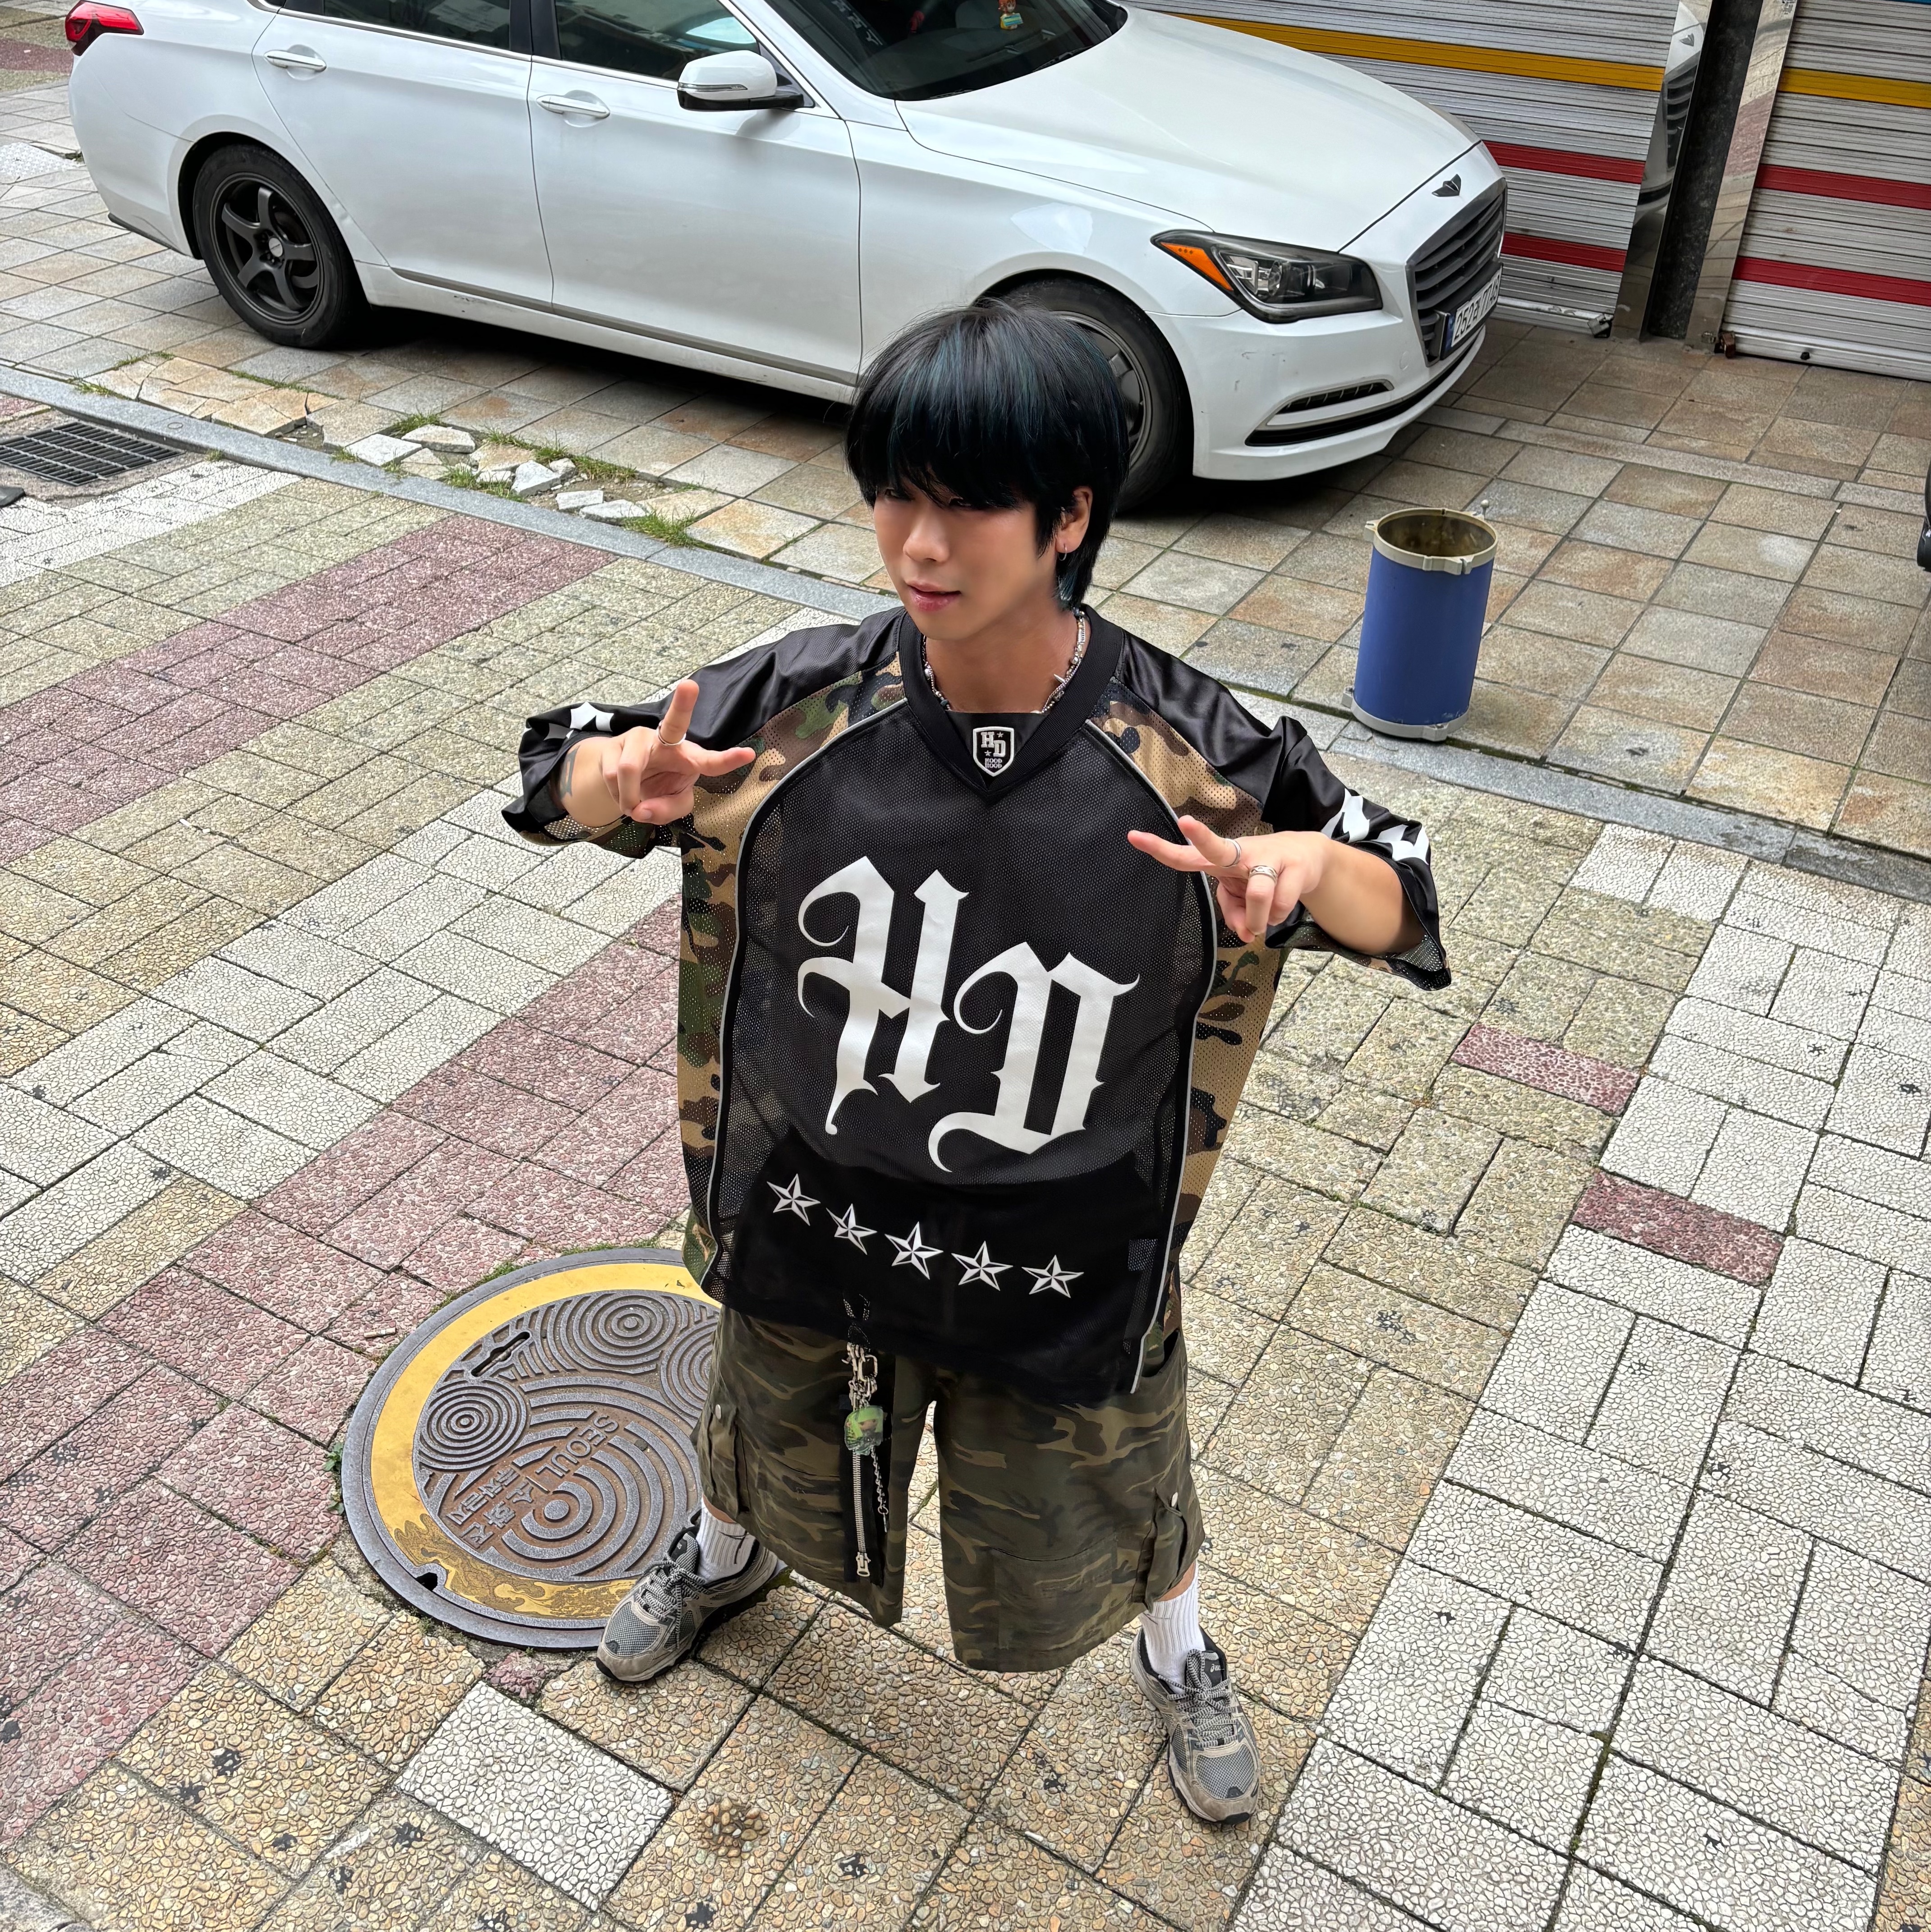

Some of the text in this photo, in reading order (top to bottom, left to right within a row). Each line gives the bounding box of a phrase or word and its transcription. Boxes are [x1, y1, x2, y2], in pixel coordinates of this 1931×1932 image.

[980, 731, 1006, 757] HD
[798, 856, 1140, 1172] HD
[535, 1414, 619, 1478] SEOUL
[445, 1465, 521, 1525] 주차금지
[461, 1480, 534, 1549] 소화전
